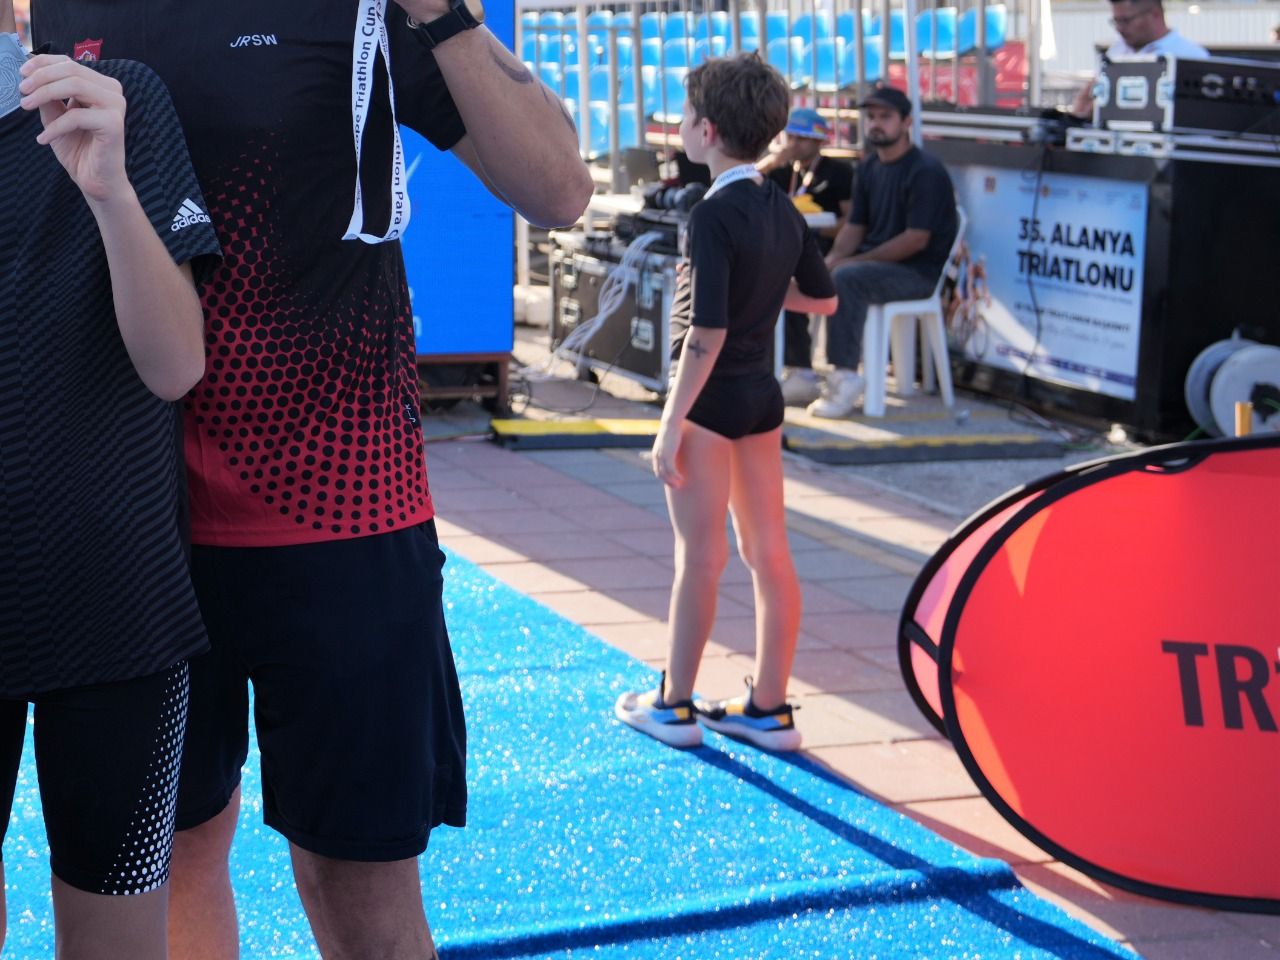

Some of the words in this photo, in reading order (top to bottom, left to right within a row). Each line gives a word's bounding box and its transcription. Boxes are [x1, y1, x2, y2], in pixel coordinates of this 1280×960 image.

[229, 33, 278, 49] JRSW
[354, 42, 372, 111] Triathlon
[170, 211, 212, 233] adidas
[394, 190, 405, 227] Para
[1017, 217, 1046, 244] 35.
[1050, 223, 1135, 258] ALANYA
[1016, 248, 1134, 292] TRİATLONU
[1161, 639, 1280, 734] TR
